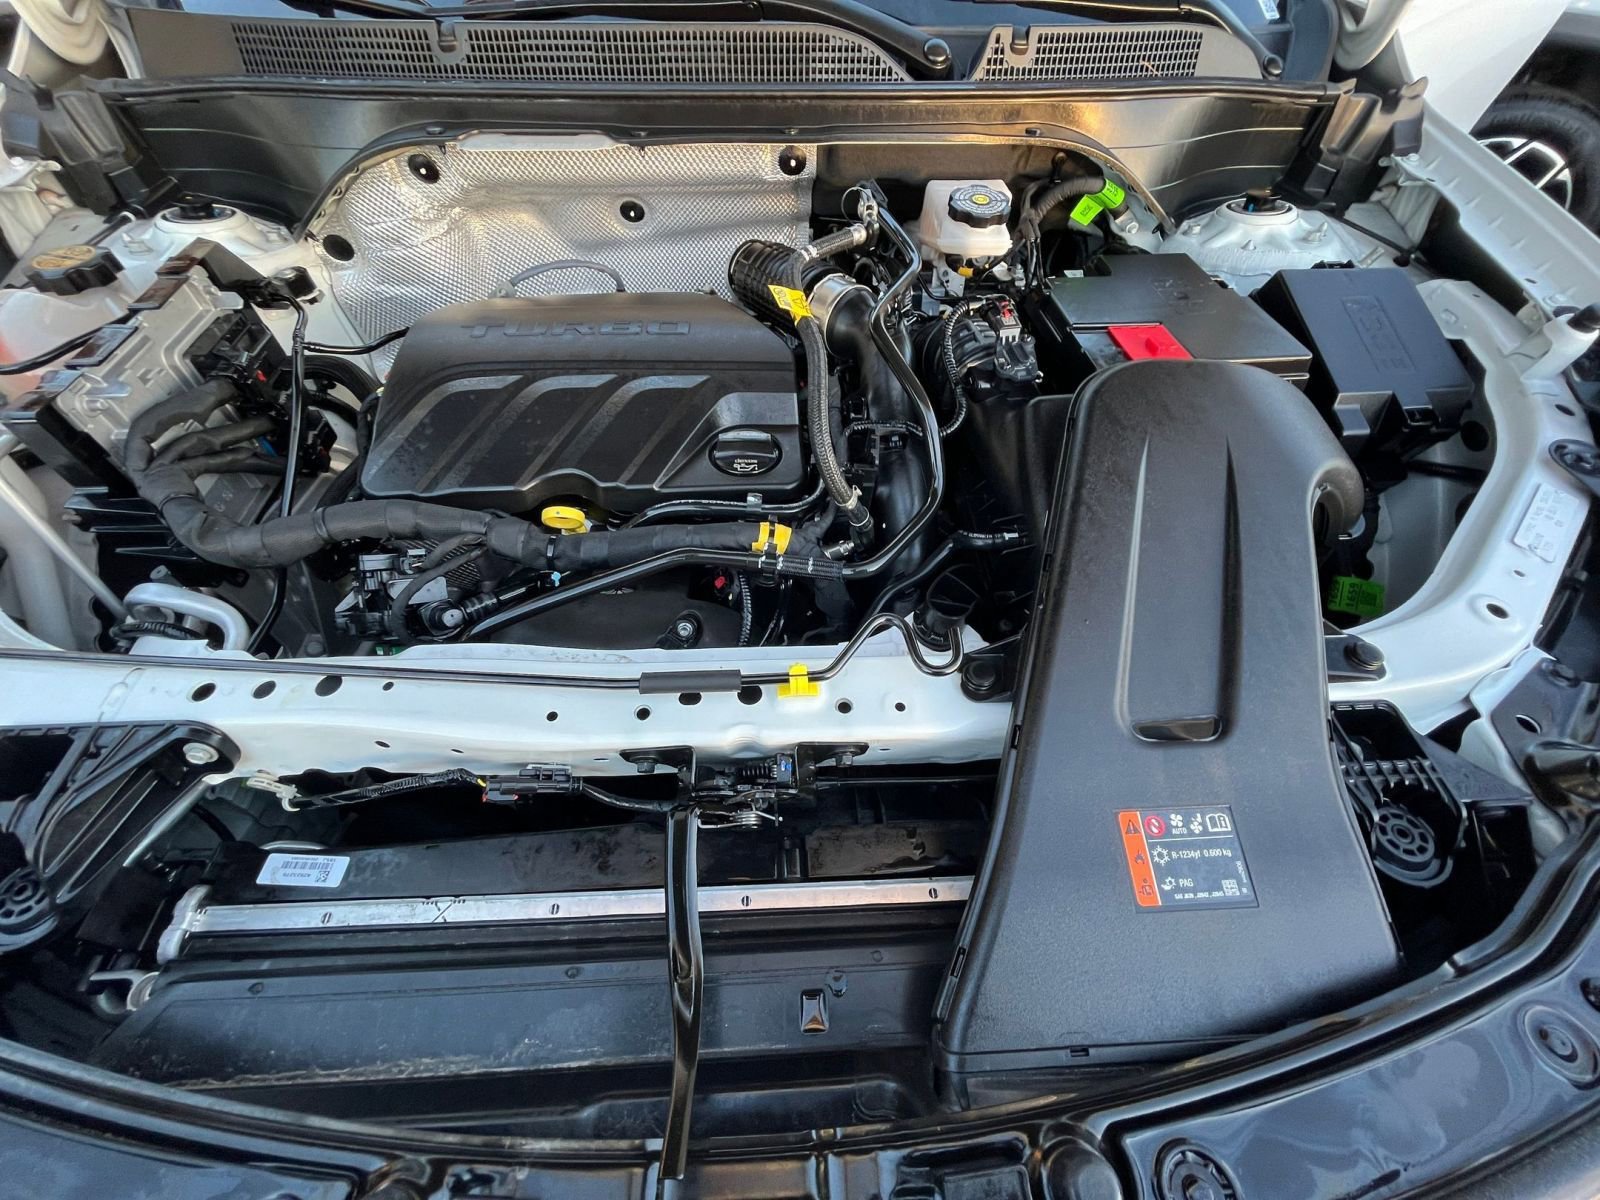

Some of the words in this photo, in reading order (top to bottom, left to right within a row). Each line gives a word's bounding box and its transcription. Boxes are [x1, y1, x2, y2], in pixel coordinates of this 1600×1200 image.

[460, 321, 690, 338] TURBO
[1223, 848, 1232, 857] kg
[1179, 878, 1194, 888] PAG
